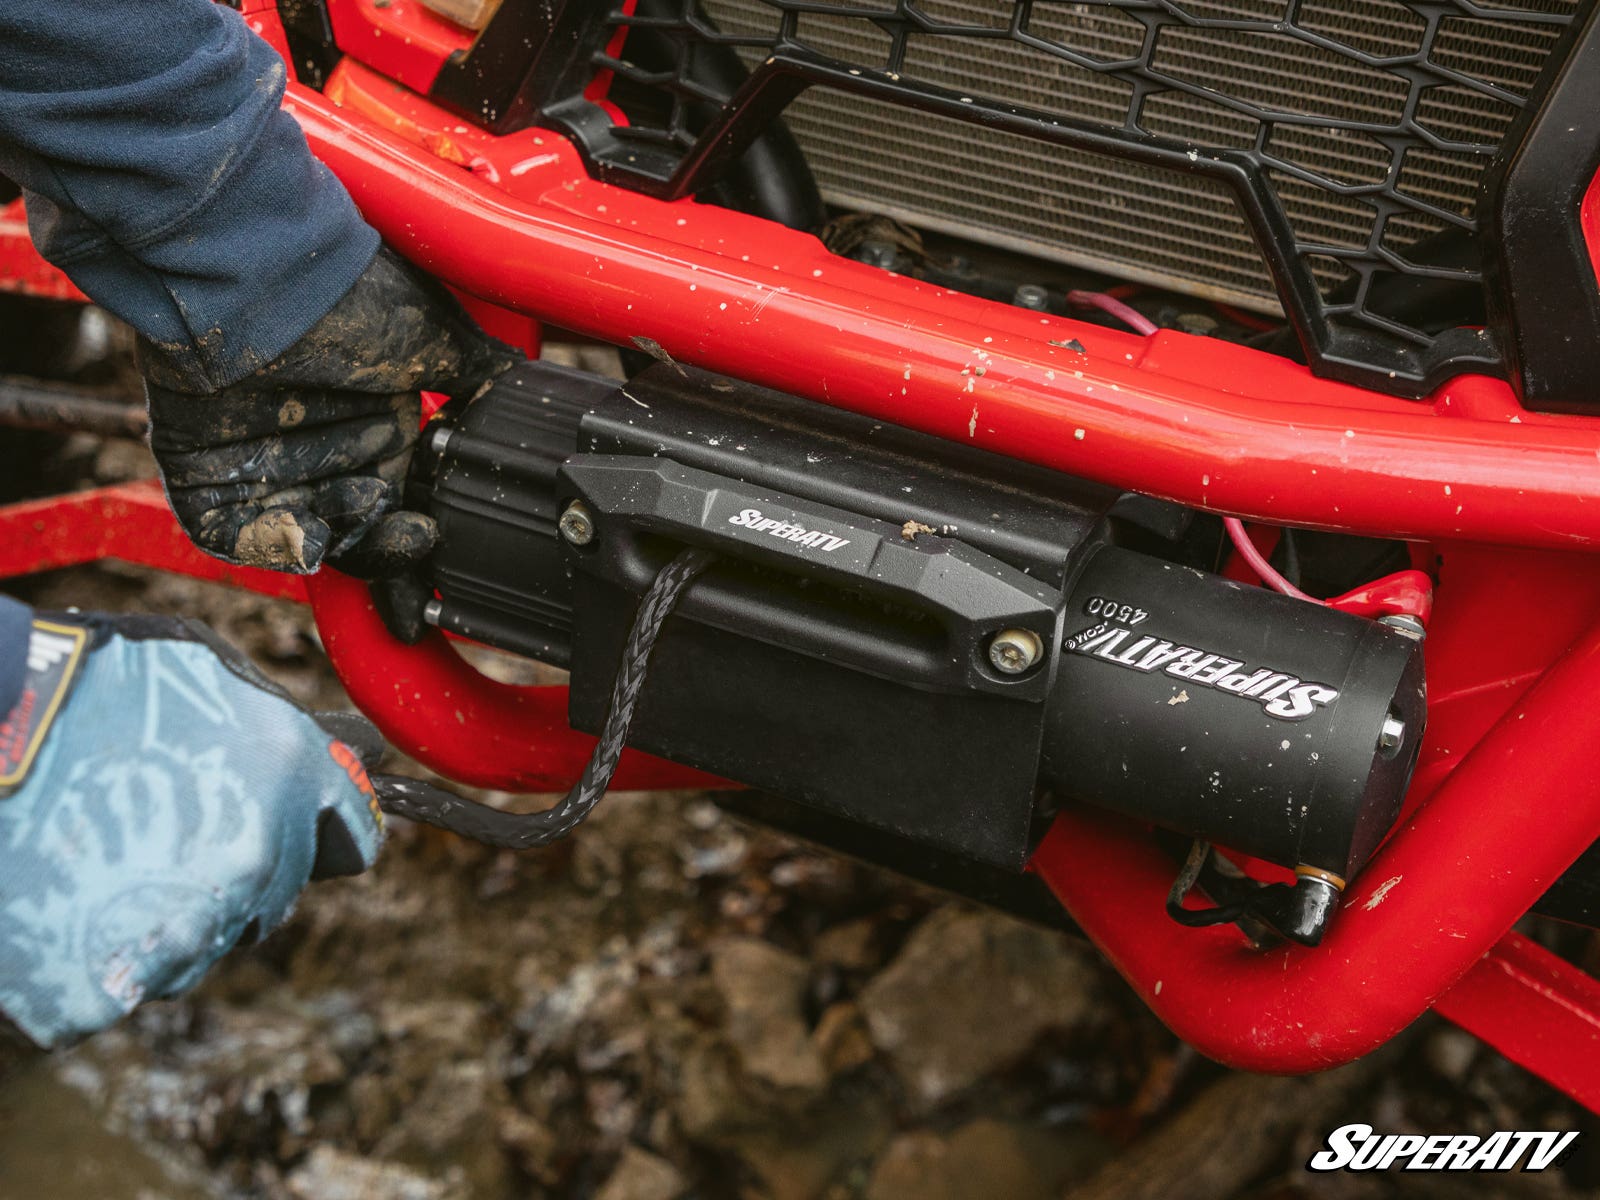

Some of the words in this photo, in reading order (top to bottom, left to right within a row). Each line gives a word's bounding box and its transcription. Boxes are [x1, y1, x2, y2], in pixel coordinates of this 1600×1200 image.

[728, 508, 851, 552] SUPERATV
[1088, 597, 1150, 626] 4500
[1079, 627, 1340, 719] SUPERATV
